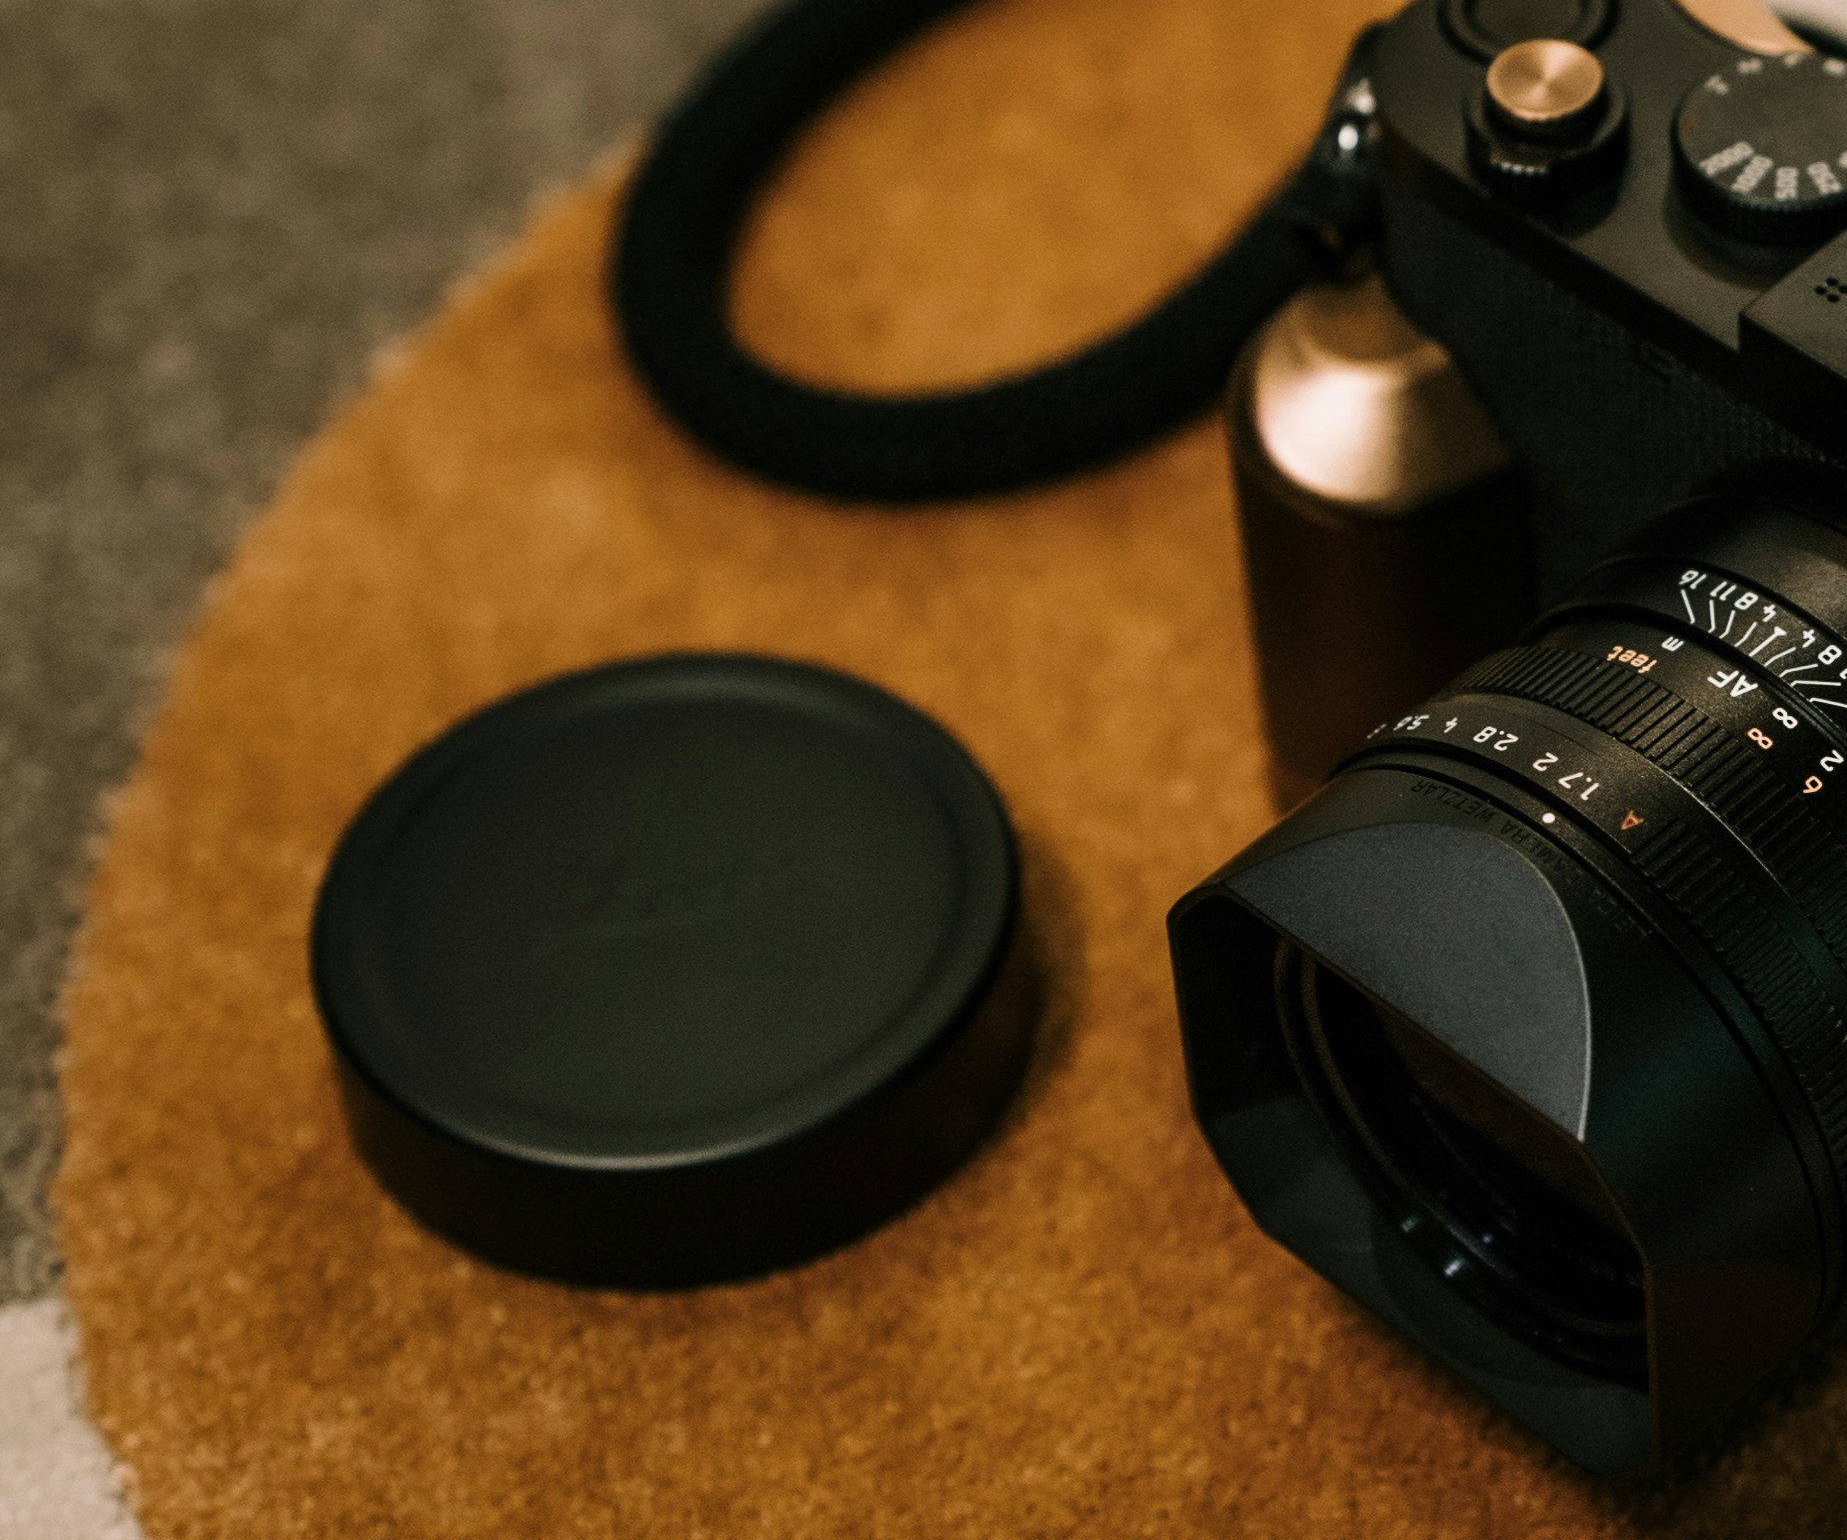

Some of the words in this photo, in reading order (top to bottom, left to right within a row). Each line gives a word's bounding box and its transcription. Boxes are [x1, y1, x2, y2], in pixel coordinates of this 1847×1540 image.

[1678, 570, 1707, 589] 16
[1710, 581, 1737, 601] 11
[1734, 592, 1758, 610] 8
[1763, 605, 1776, 622] 4
[1661, 636, 1684, 651] m
[1802, 629, 1816, 648] 4
[1607, 646, 1657, 673] feet
[1818, 645, 1842, 665] 8
[1707, 671, 1758, 697] AF
[1444, 717, 1457, 733] 4
[1473, 726, 1519, 751] 2.8
[1533, 752, 1558, 771] 2
[1820, 749, 1844, 772] 2
[1558, 772, 1599, 800] 1.7
[1802, 775, 1823, 794] 6
[1410, 779, 1495, 823] WETZLAR
[1621, 810, 1644, 830] A
